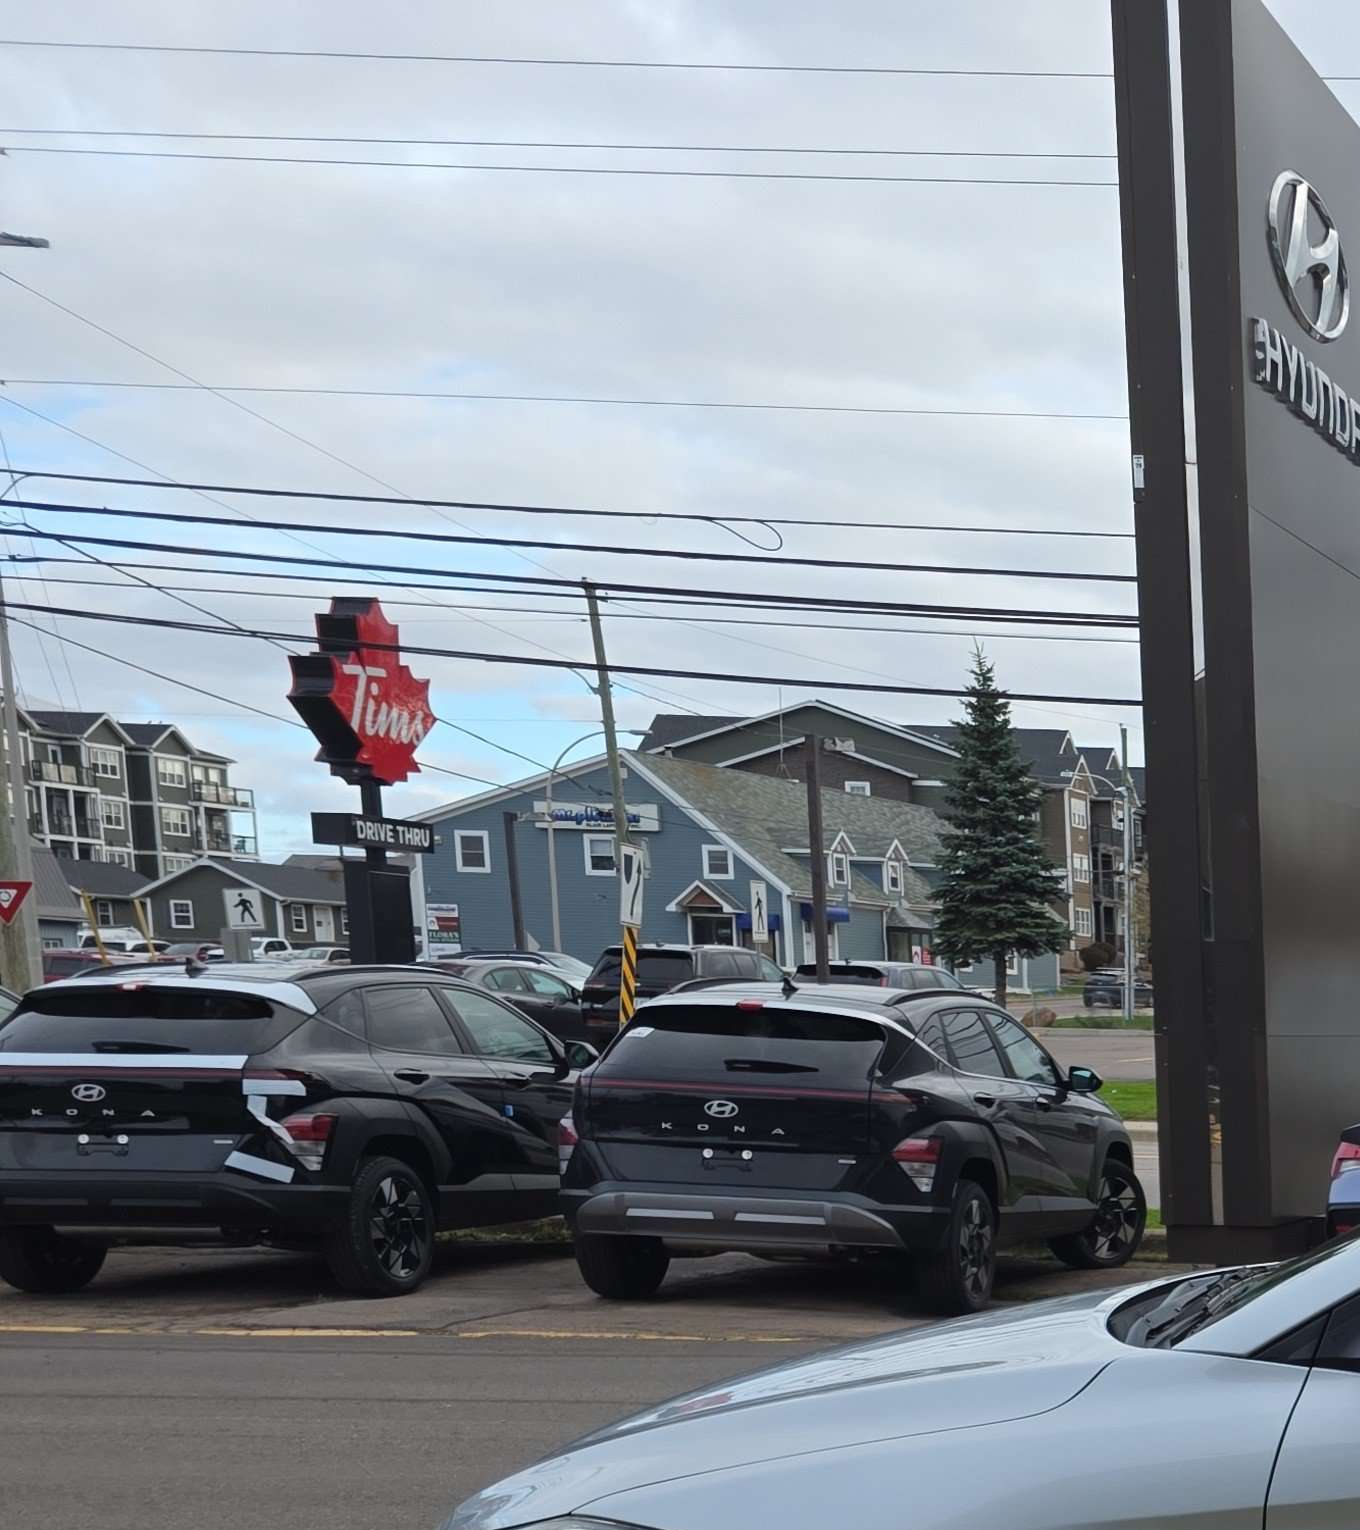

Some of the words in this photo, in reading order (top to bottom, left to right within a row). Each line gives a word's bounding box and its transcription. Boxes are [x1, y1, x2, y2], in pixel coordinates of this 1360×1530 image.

[342, 664, 425, 746] Tims
[356, 820, 395, 843] DRIVE
[397, 826, 430, 847] THRU
[31, 1108, 155, 1117] KONA
[661, 1121, 785, 1135] KONA
